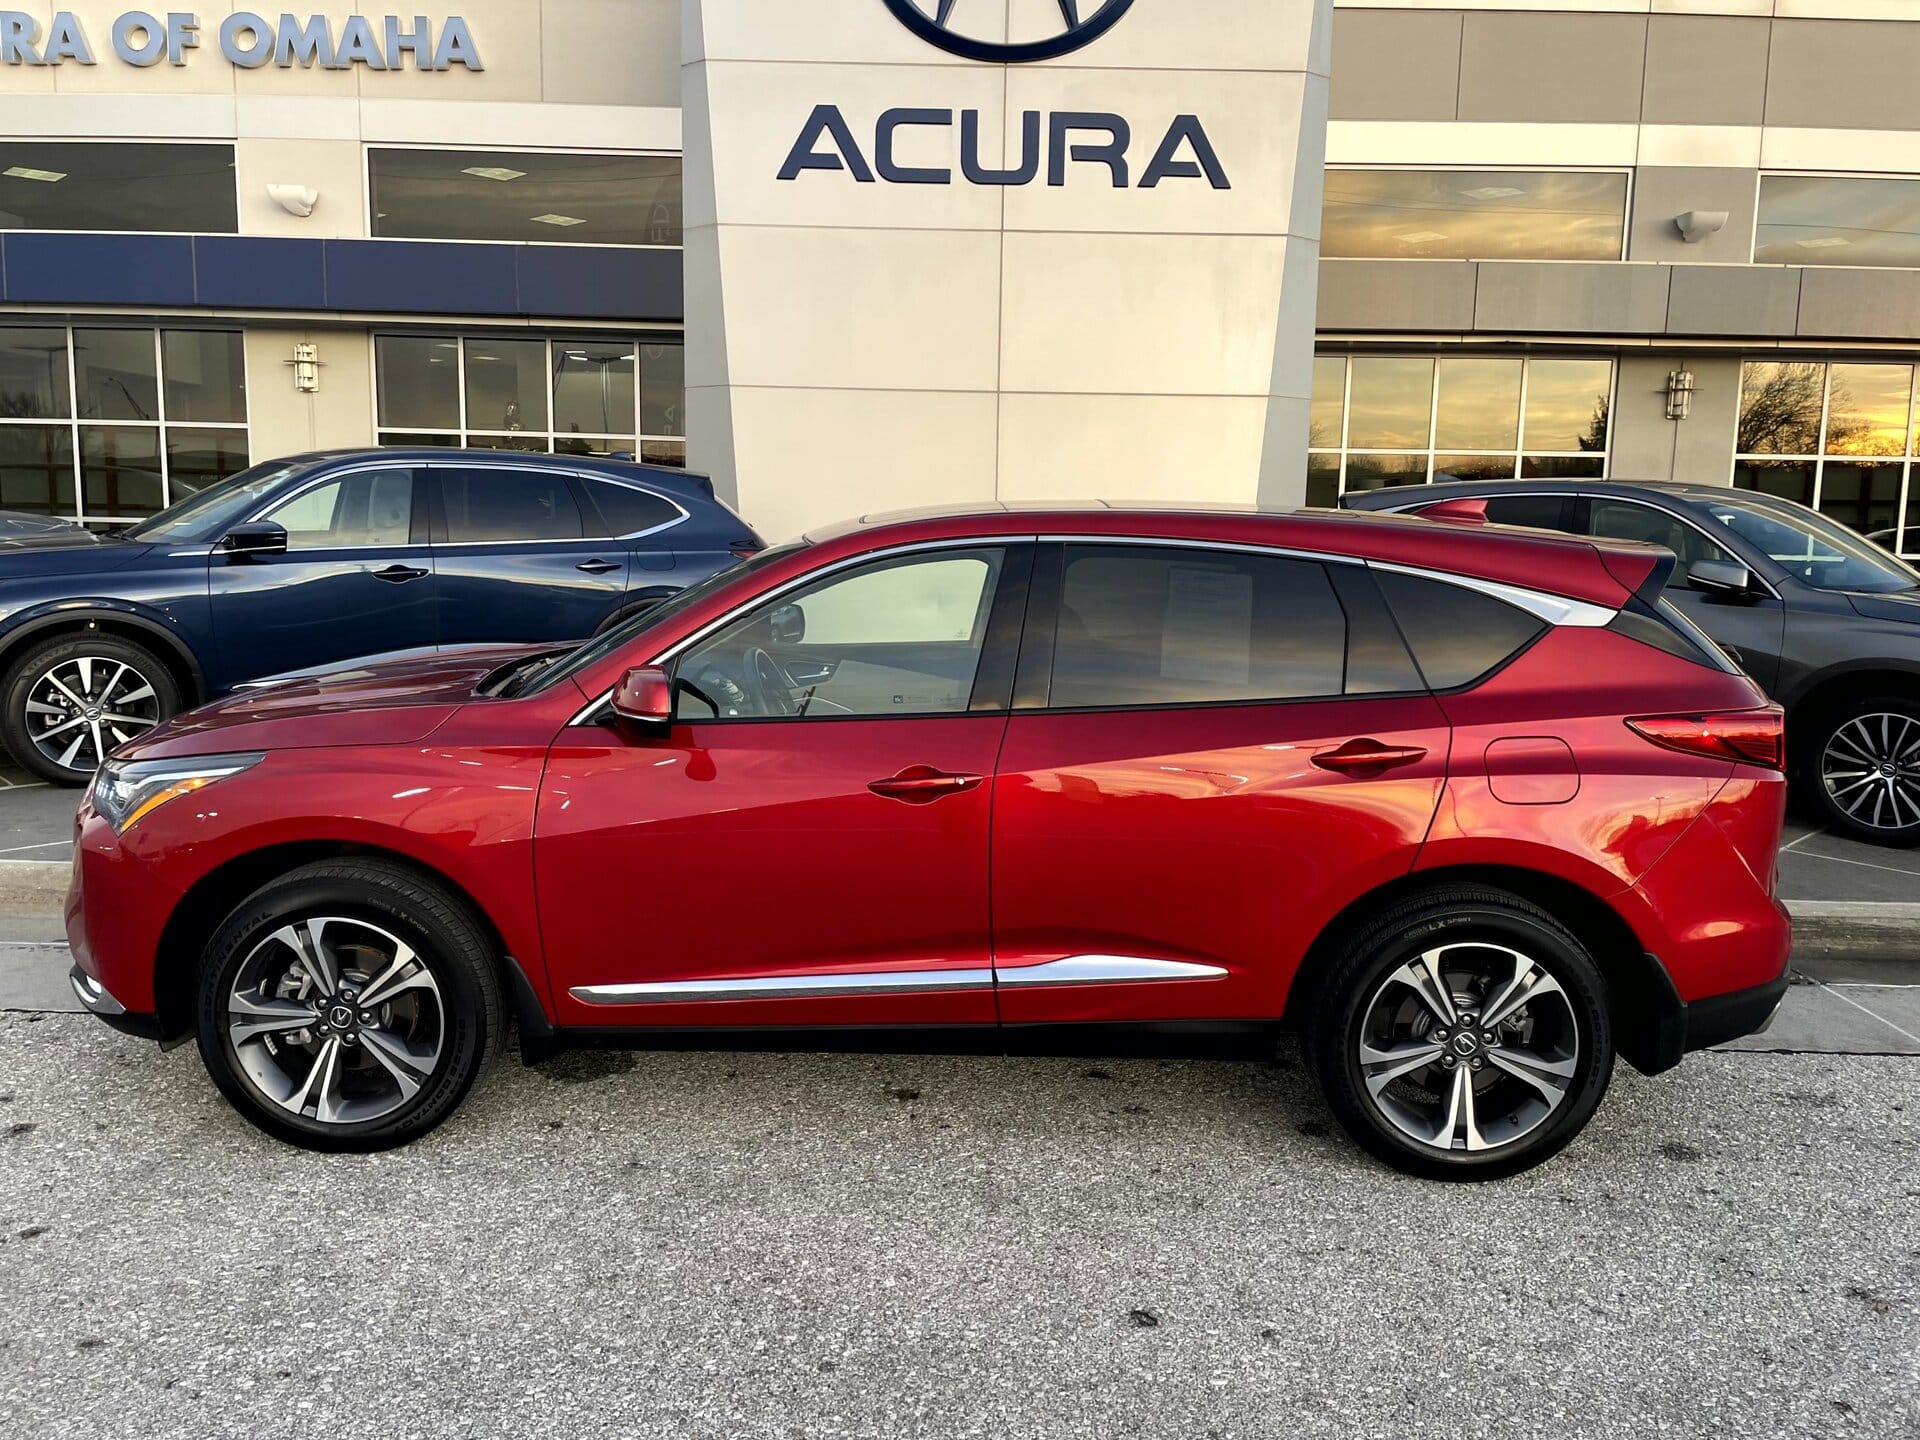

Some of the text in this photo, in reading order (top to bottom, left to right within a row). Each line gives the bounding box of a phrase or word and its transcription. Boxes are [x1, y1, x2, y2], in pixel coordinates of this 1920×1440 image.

[111, 10, 200, 67] OF
[219, 13, 485, 71] OMAHA
[776, 104, 1231, 190] ACURA
[1427, 920, 1447, 932] LX
